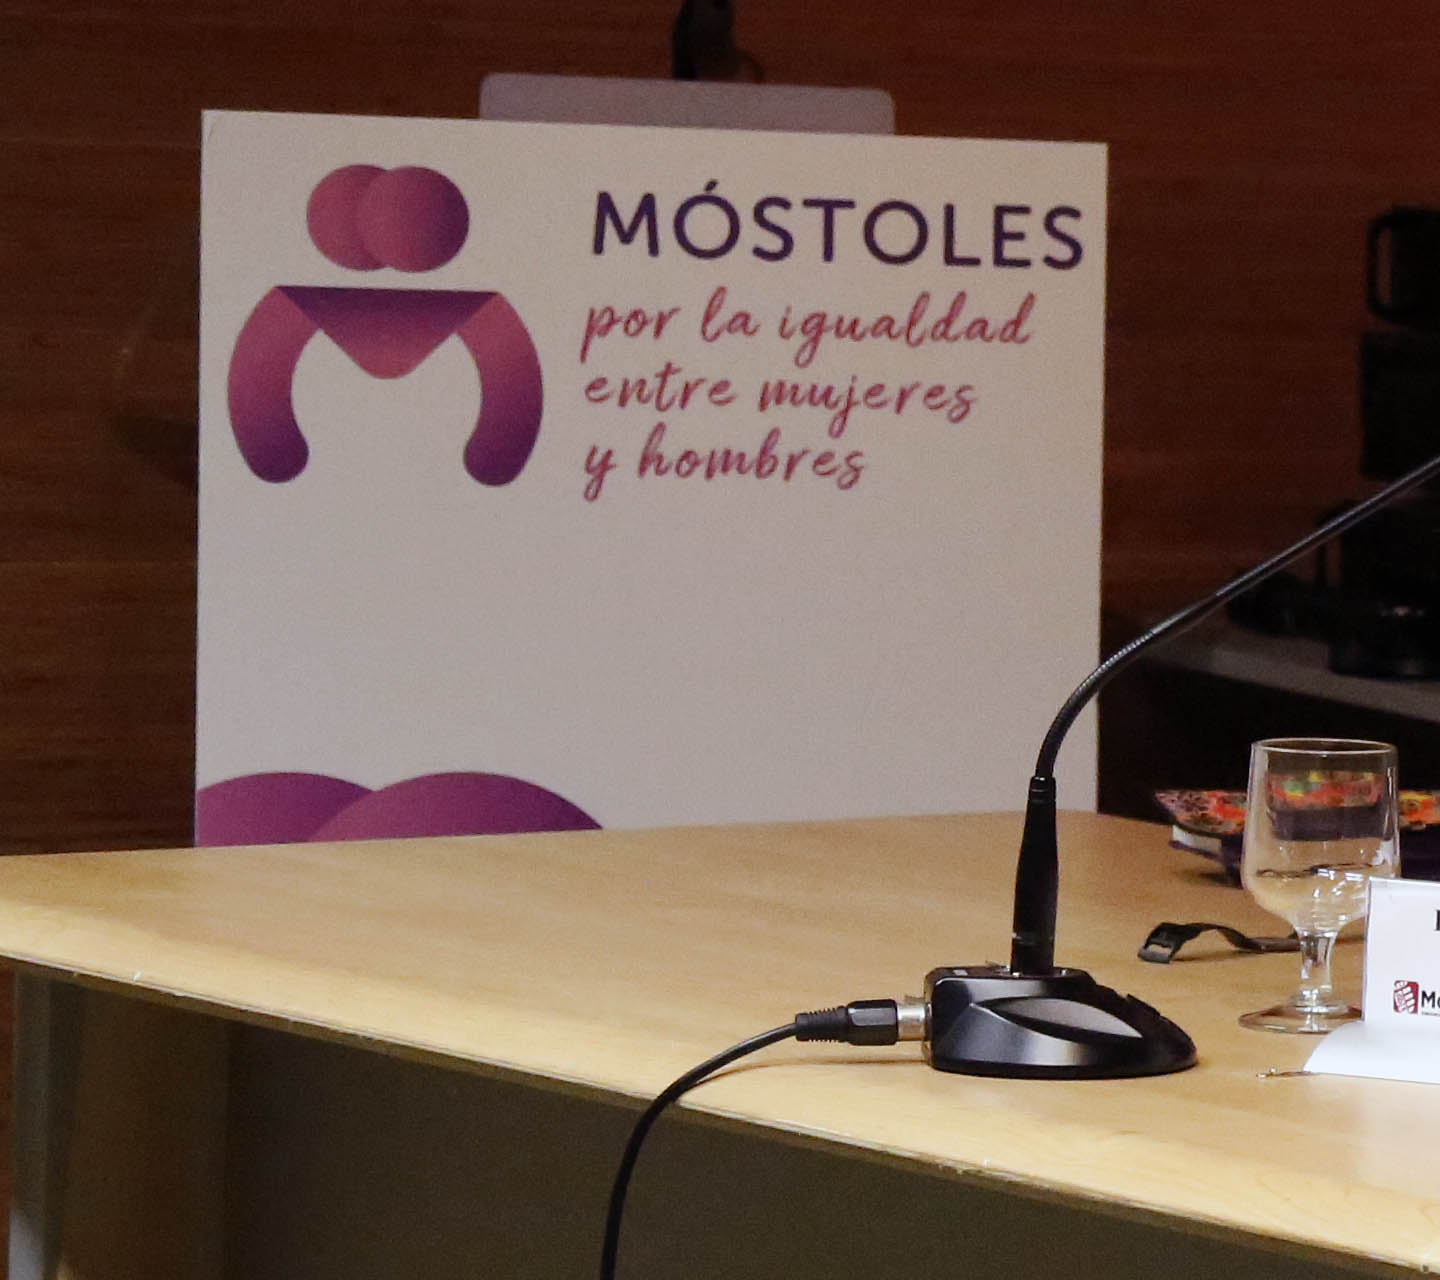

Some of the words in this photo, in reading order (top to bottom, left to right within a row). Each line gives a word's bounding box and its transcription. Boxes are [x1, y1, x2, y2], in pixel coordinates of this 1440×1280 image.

[592, 179, 1083, 270] MÓSTOLES
[579, 305, 680, 363] por
[700, 286, 760, 342] la
[777, 291, 1037, 368] igualdad
[583, 361, 737, 412] entre
[757, 376, 975, 439] mujeres
[583, 445, 617, 502] y
[637, 421, 864, 490] hombres
